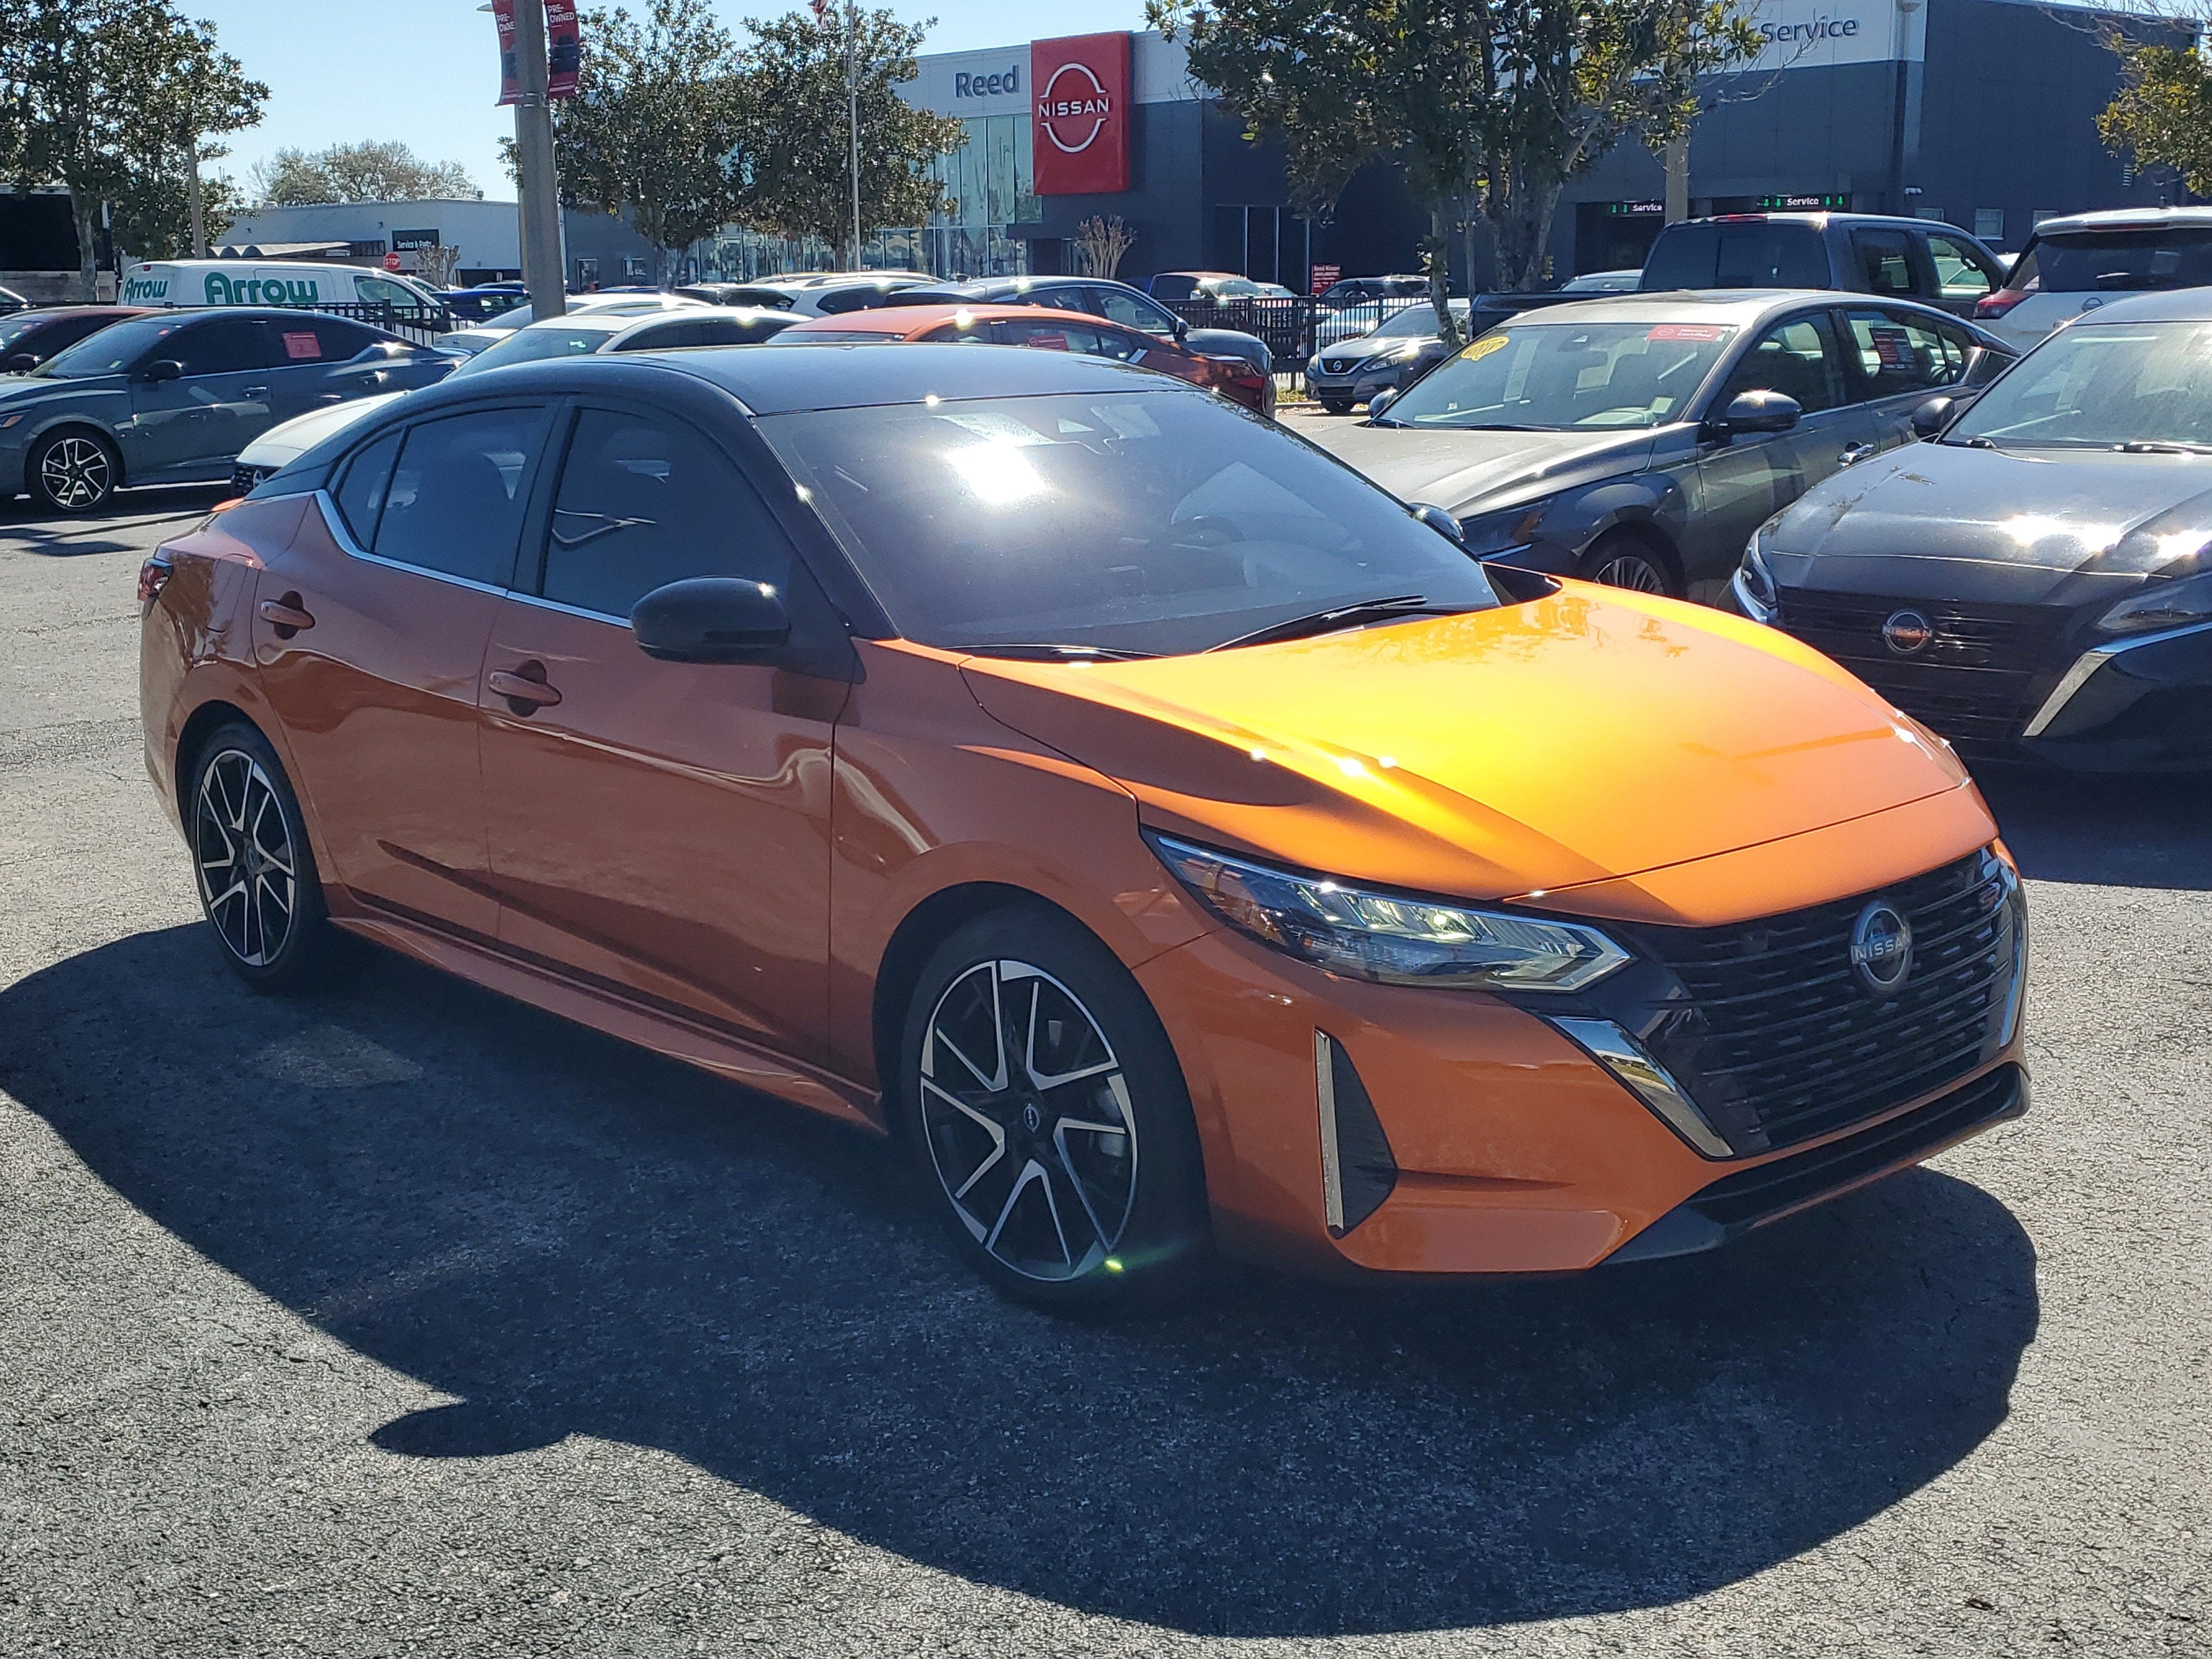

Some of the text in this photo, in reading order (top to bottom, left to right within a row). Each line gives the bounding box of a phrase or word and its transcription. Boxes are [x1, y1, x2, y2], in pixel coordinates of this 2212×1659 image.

[549, 4, 564, 13] PRE-
[550, 12, 574, 22] OWNED
[499, 22, 515, 32] OWNE
[1760, 15, 1859, 43] Service
[956, 65, 1019, 98] Reed
[1039, 98, 1109, 117] NISSAN
[1787, 197, 1819, 206] Service
[397, 240, 414, 249] Service
[123, 277, 168, 305] Arrow
[204, 272, 319, 304] Arrow
[1854, 934, 1910, 961] NISSAN
